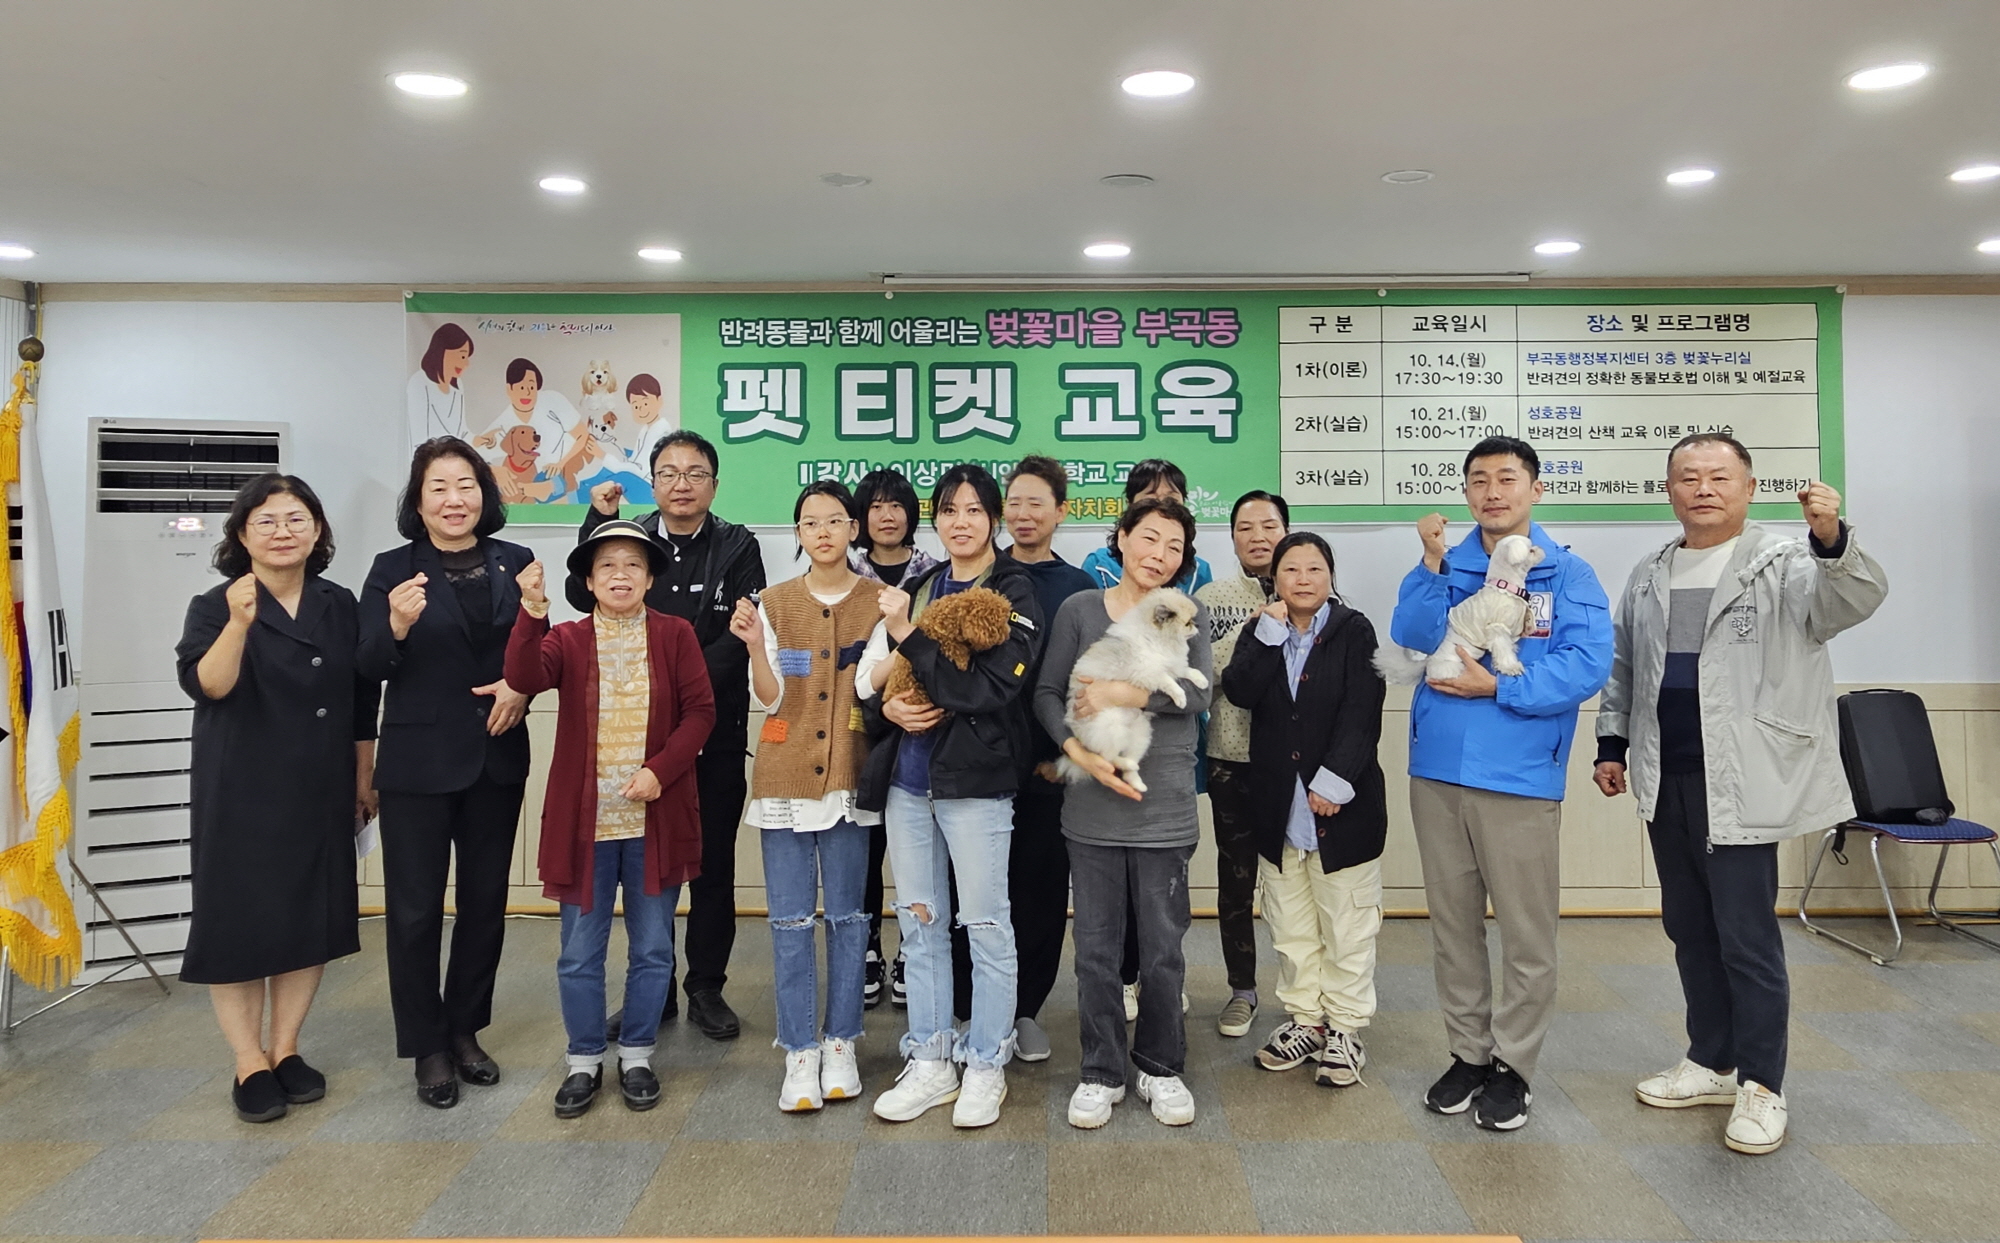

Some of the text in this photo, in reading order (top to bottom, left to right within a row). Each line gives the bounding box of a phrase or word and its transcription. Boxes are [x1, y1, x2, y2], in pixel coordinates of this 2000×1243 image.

[721, 310, 1239, 346] 반려동물과 함께 어울리는 벚꽃마을 부곡동
[1411, 314, 1488, 334] 교육일시
[1586, 313, 1751, 333] 장소 및 프로그램명
[1409, 352, 1487, 369] 10. 14.(월)
[1525, 350, 1752, 366] 부곡동행정복지센터 3층 벚꽃누리실
[1295, 361, 1368, 379] 1차(이론)
[1394, 371, 1504, 386] 17:30~19:30
[1526, 369, 1806, 387] 반려견의 정확한 동물보호법 이해 및 예절교육
[722, 365, 1237, 440] 펫 티켓 교육
[1410, 406, 1488, 422] 10. 21.(월)
[1527, 405, 1583, 421] 성호공원
[1294, 415, 1369, 433] 2차(실습)
[1395, 425, 1504, 440] 15:00~17:00
[1527, 425, 1583, 441] 반려견의
[1587, 425, 1616, 440] 산책
[1620, 425, 1649, 440] 교육
[1653, 425, 1682, 440] 이론
[1410, 463, 1434, 478] 10.
[1538, 459, 1584, 475] 호공원
[1295, 469, 1369, 487] 3차(실습)
[1543, 480, 1583, 496] 려견과
[1586, 479, 1640, 495] 함께하는
